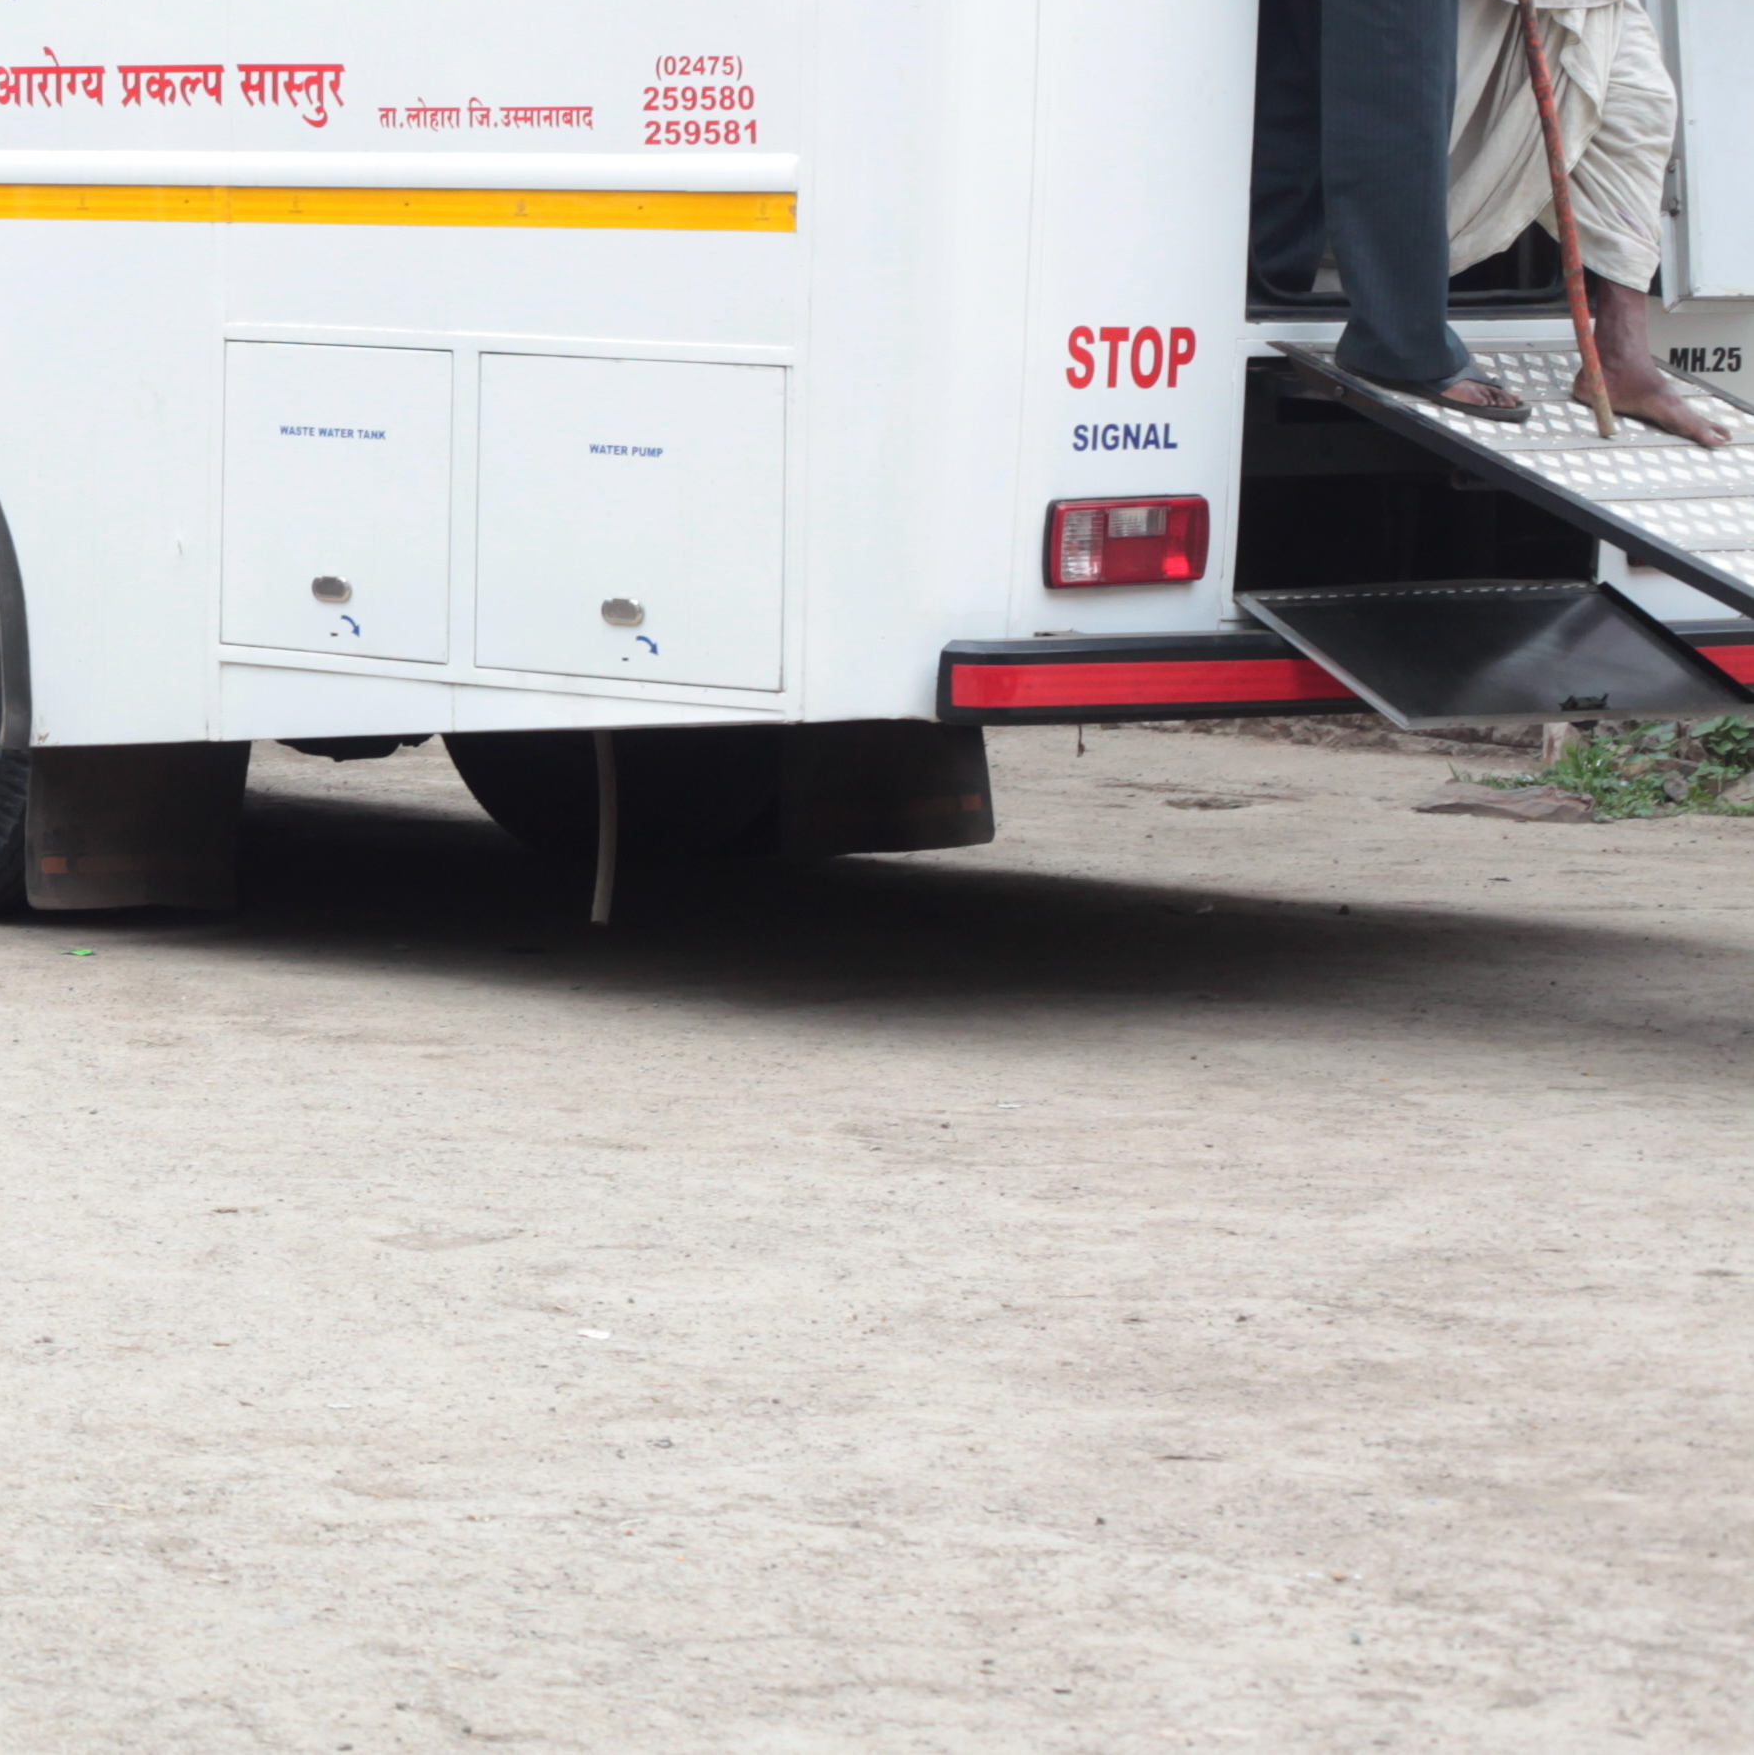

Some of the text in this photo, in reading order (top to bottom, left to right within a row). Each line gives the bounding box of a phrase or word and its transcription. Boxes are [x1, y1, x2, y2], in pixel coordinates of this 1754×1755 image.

[656, 56, 743, 81] (02475)
[117, 64, 225, 107] प्रकल्प
[237, 64, 345, 128] सास्तुर
[643, 85, 755, 112] 259580
[644, 119, 757, 146] 259581
[1066, 326, 1197, 390] STOP
[1669, 347, 1741, 373] MH.25
[280, 425, 386, 441] WASTE WATER TANK
[1073, 423, 1178, 451] SIGNAL
[589, 443, 664, 458] WATER PUMP
